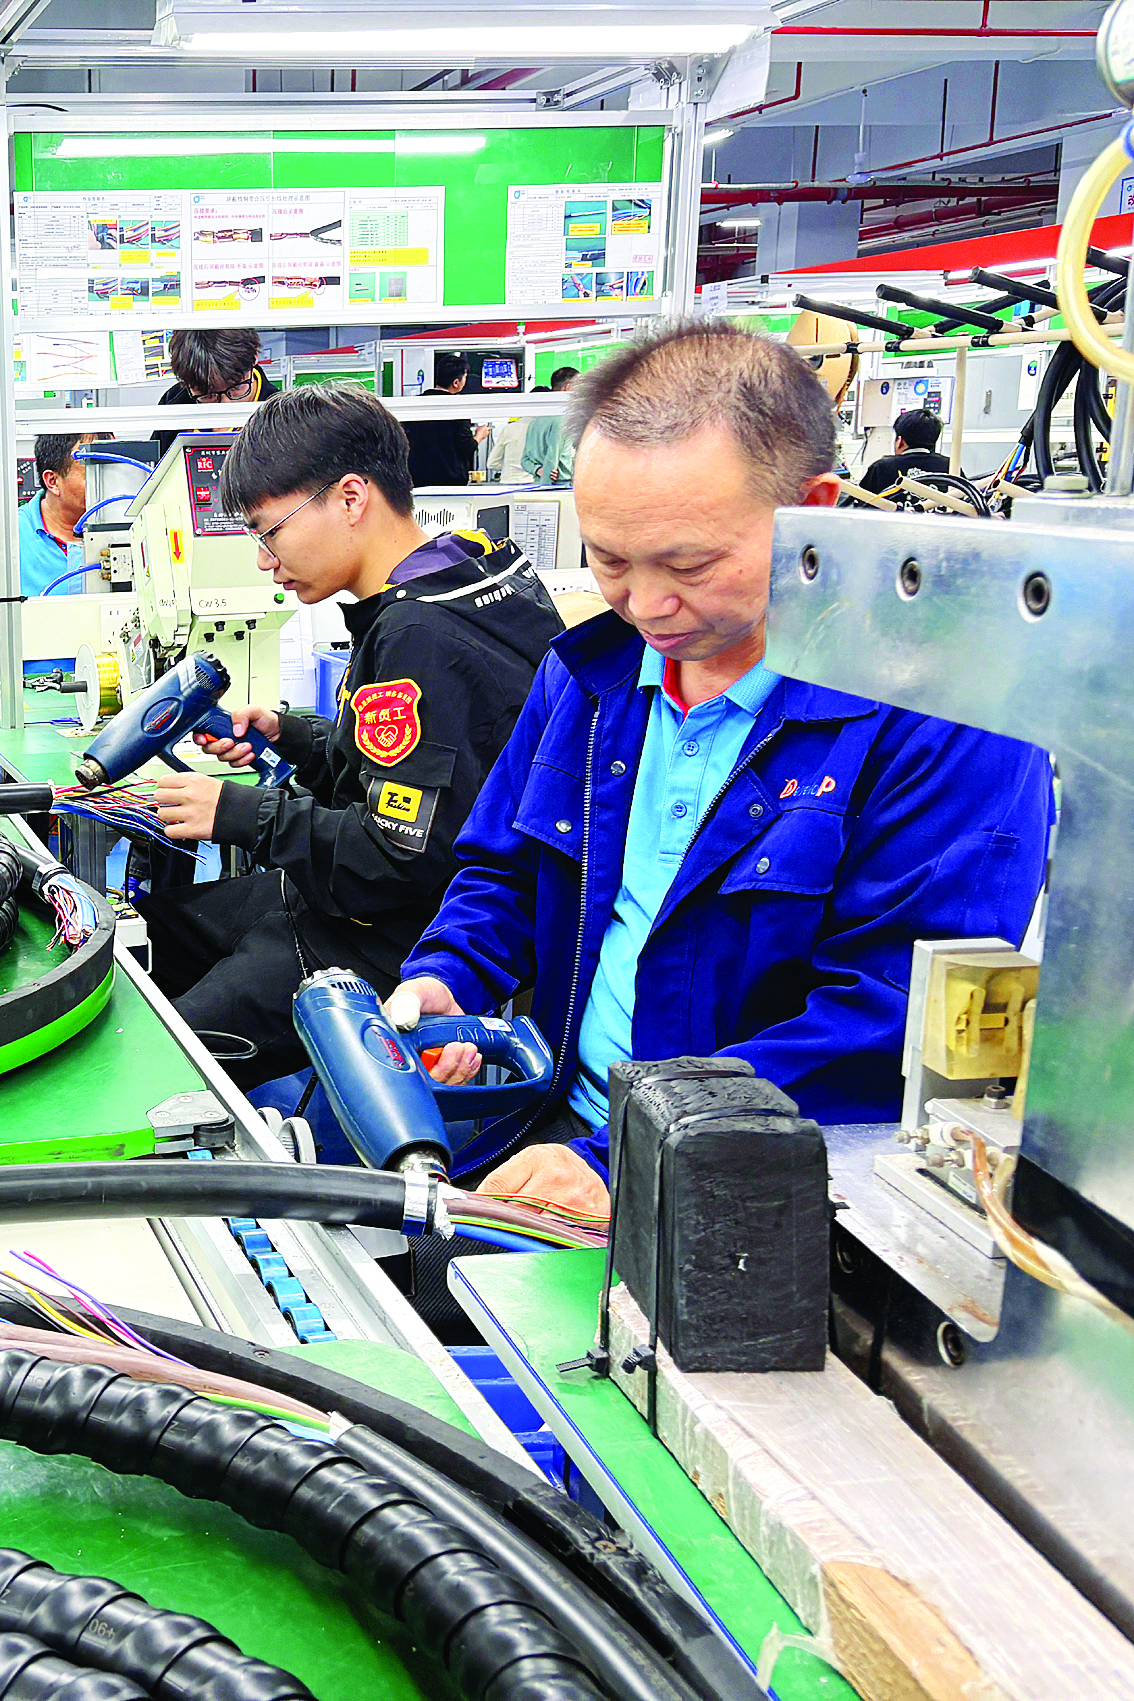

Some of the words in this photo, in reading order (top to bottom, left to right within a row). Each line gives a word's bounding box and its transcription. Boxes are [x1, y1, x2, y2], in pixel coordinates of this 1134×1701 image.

[197, 461, 213, 469] RFC
[364, 706, 407, 724] 新员工
[398, 824, 425, 838] FIVE
